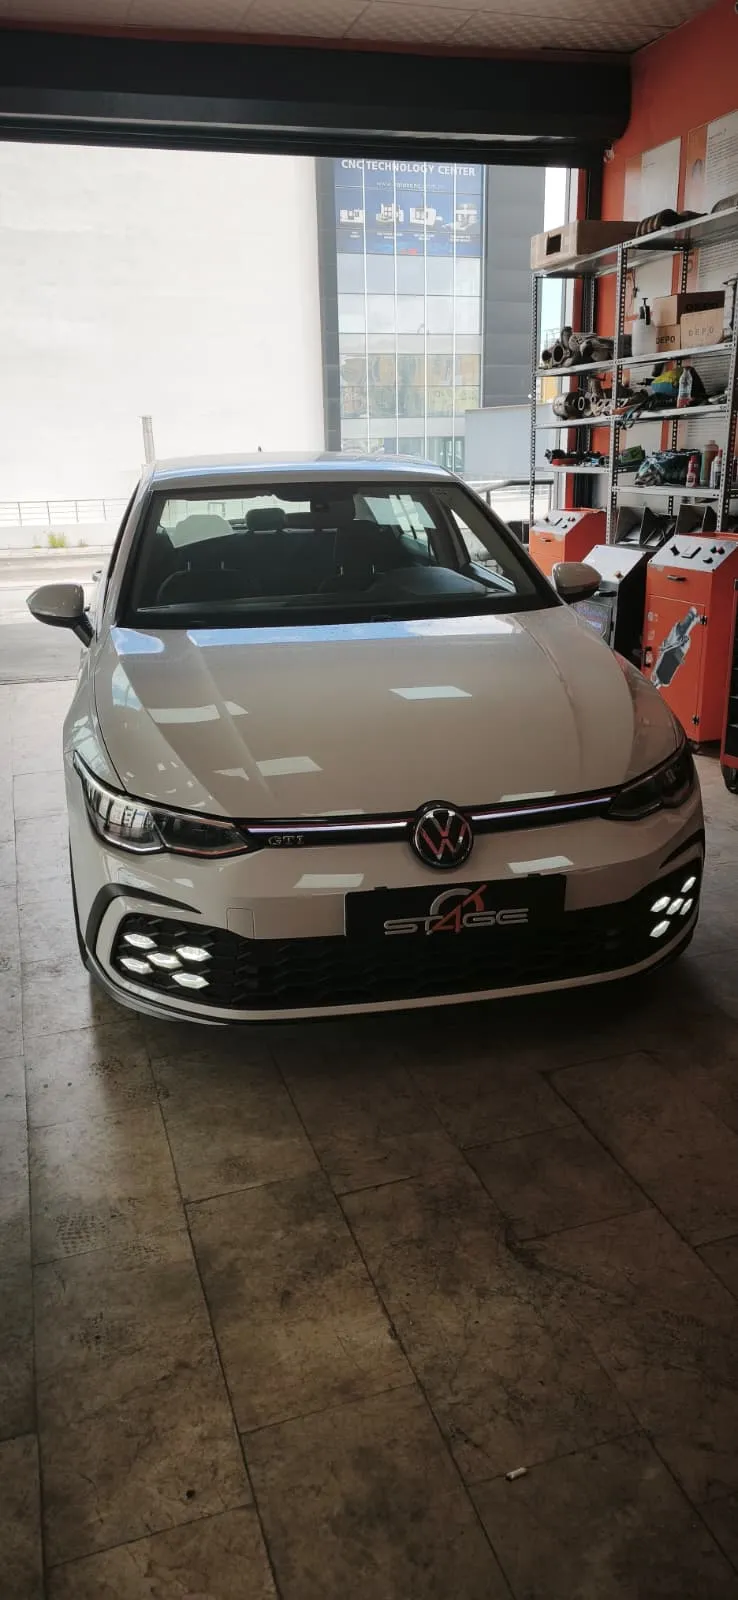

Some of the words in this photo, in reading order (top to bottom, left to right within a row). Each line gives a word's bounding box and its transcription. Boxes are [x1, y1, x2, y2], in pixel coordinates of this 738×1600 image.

[341, 159, 364, 169] CNC
[365, 160, 434, 173] TECHNOLOGY
[438, 165, 476, 176] CENTER
[688, 327, 714, 337] DEPO
[656, 335, 676, 345] DEPO
[268, 835, 305, 847] GTI
